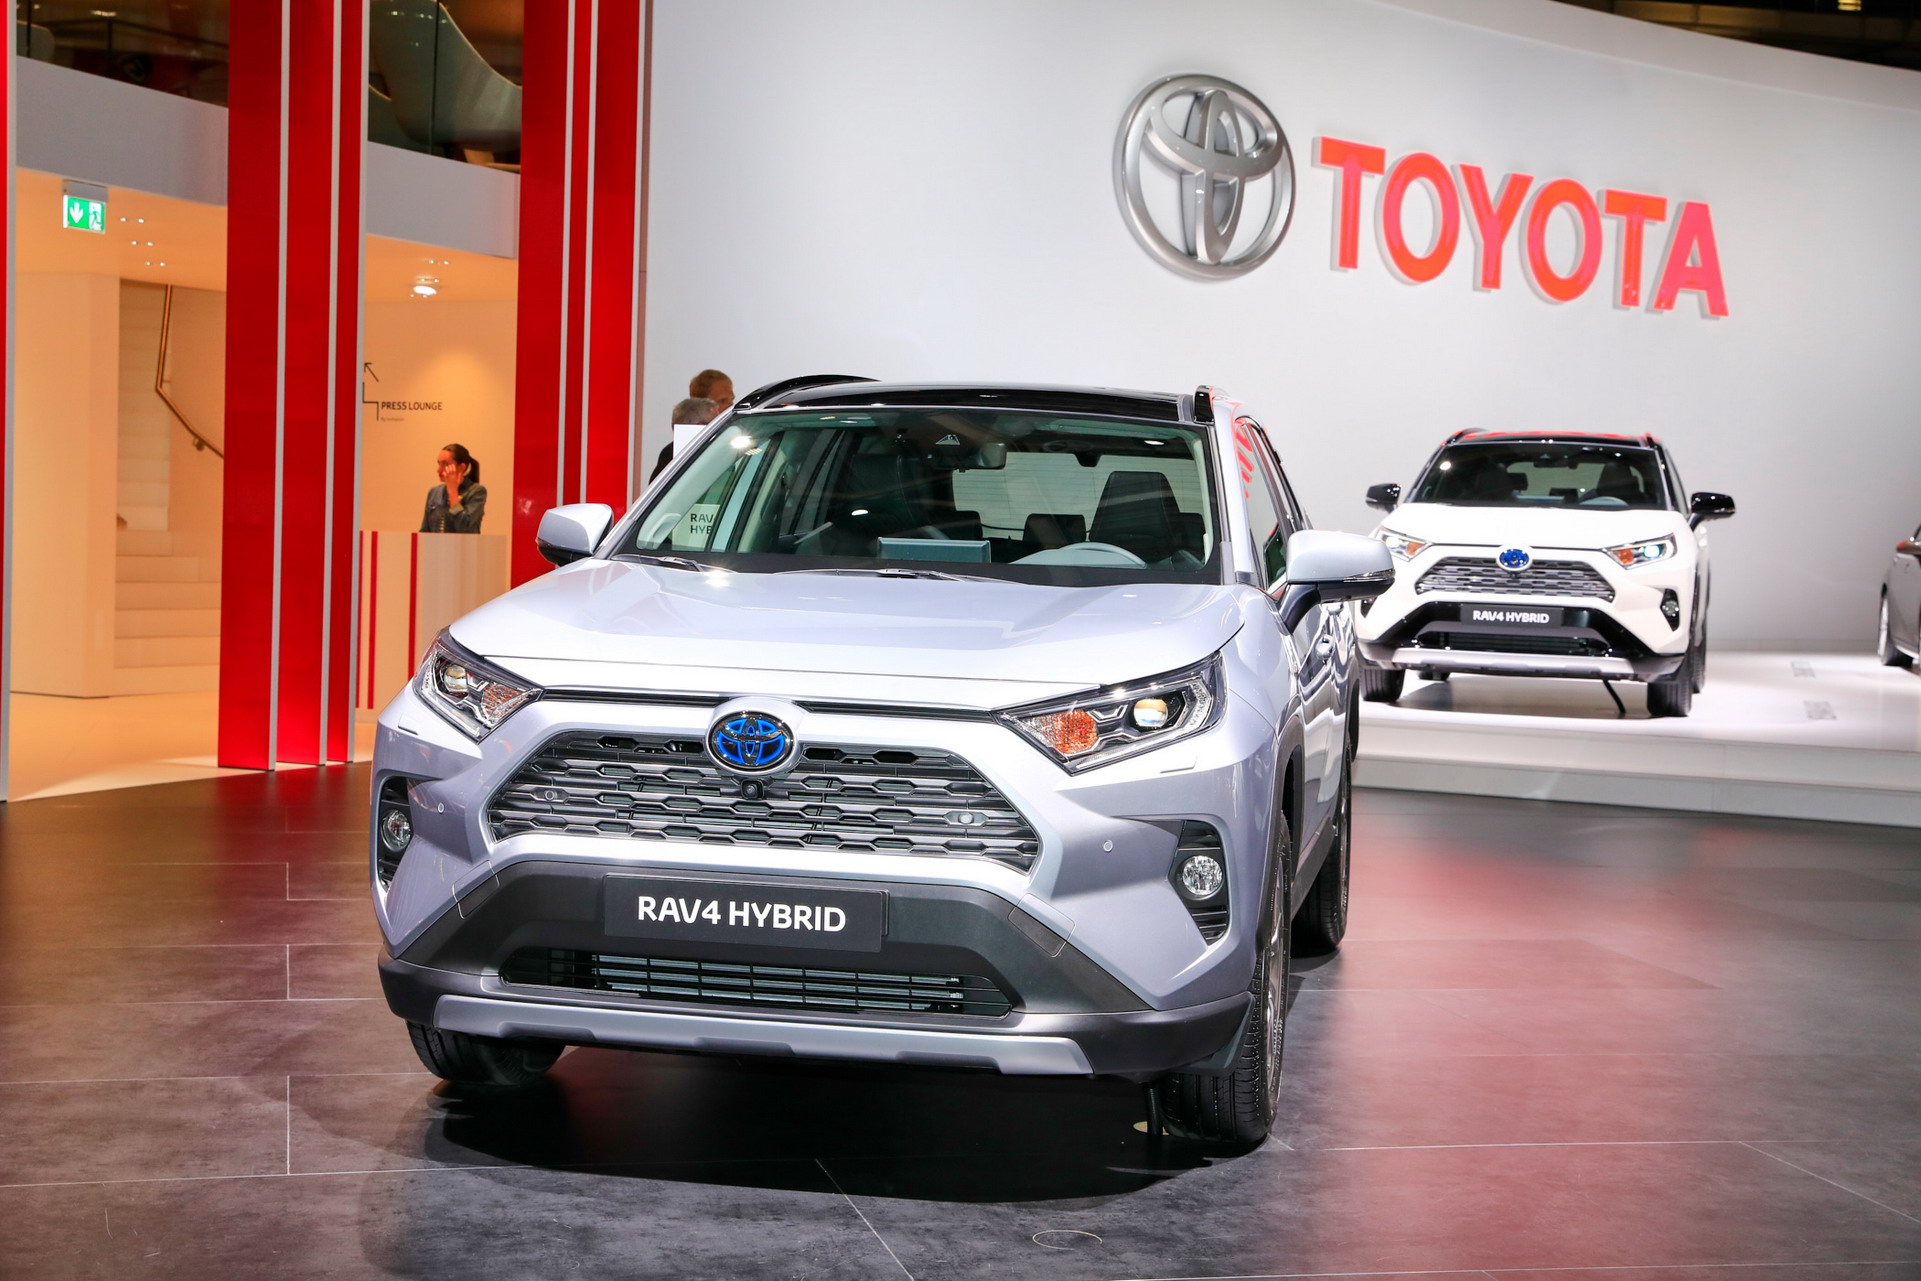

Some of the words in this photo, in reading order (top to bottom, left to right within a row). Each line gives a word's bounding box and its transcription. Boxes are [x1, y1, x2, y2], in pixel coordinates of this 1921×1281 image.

[1320, 136, 1729, 316] TOYOTA
[381, 401, 407, 411] PRESS
[408, 401, 443, 411] LOUNGE
[690, 513, 714, 523] RAV
[690, 524, 711, 534] HYB
[1472, 610, 1504, 622] RAV4
[1505, 611, 1550, 624] HYBRID
[638, 896, 721, 924] RAV4
[729, 901, 846, 932] HYBRID
